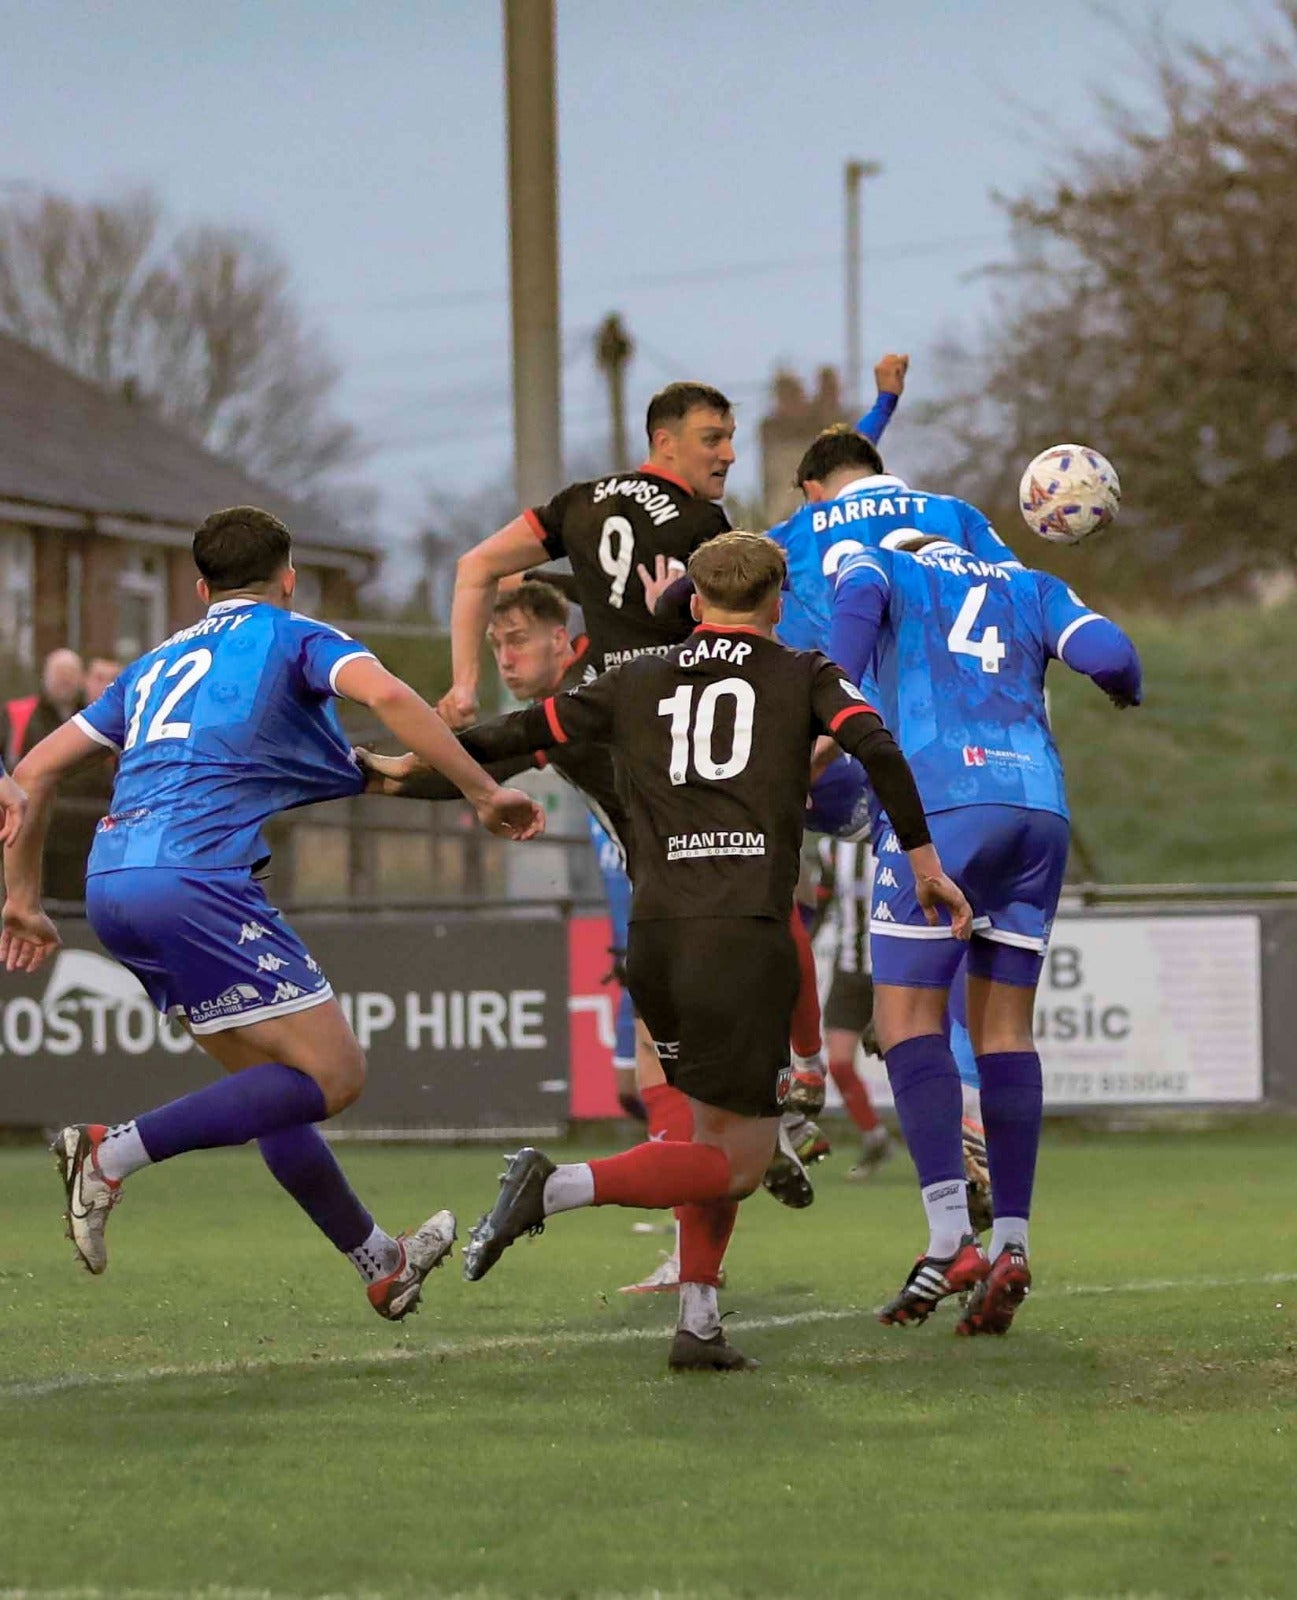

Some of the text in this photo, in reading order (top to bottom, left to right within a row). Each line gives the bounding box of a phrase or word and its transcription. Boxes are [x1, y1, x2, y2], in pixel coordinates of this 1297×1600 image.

[594, 478, 680, 527] SAMPSON
[813, 497, 928, 533] BARRATT
[598, 515, 635, 609] 9
[947, 582, 1006, 674] 4
[603, 644, 676, 666] PHANTO
[679, 637, 753, 668] CARR
[123, 647, 213, 751] 12
[657, 677, 756, 786] 10
[668, 831, 765, 852] PHANTOM
[190, 993, 241, 1016] A CLASS
[192, 1003, 244, 1022] COACH HIRE
[405, 989, 548, 1050] HIRE
